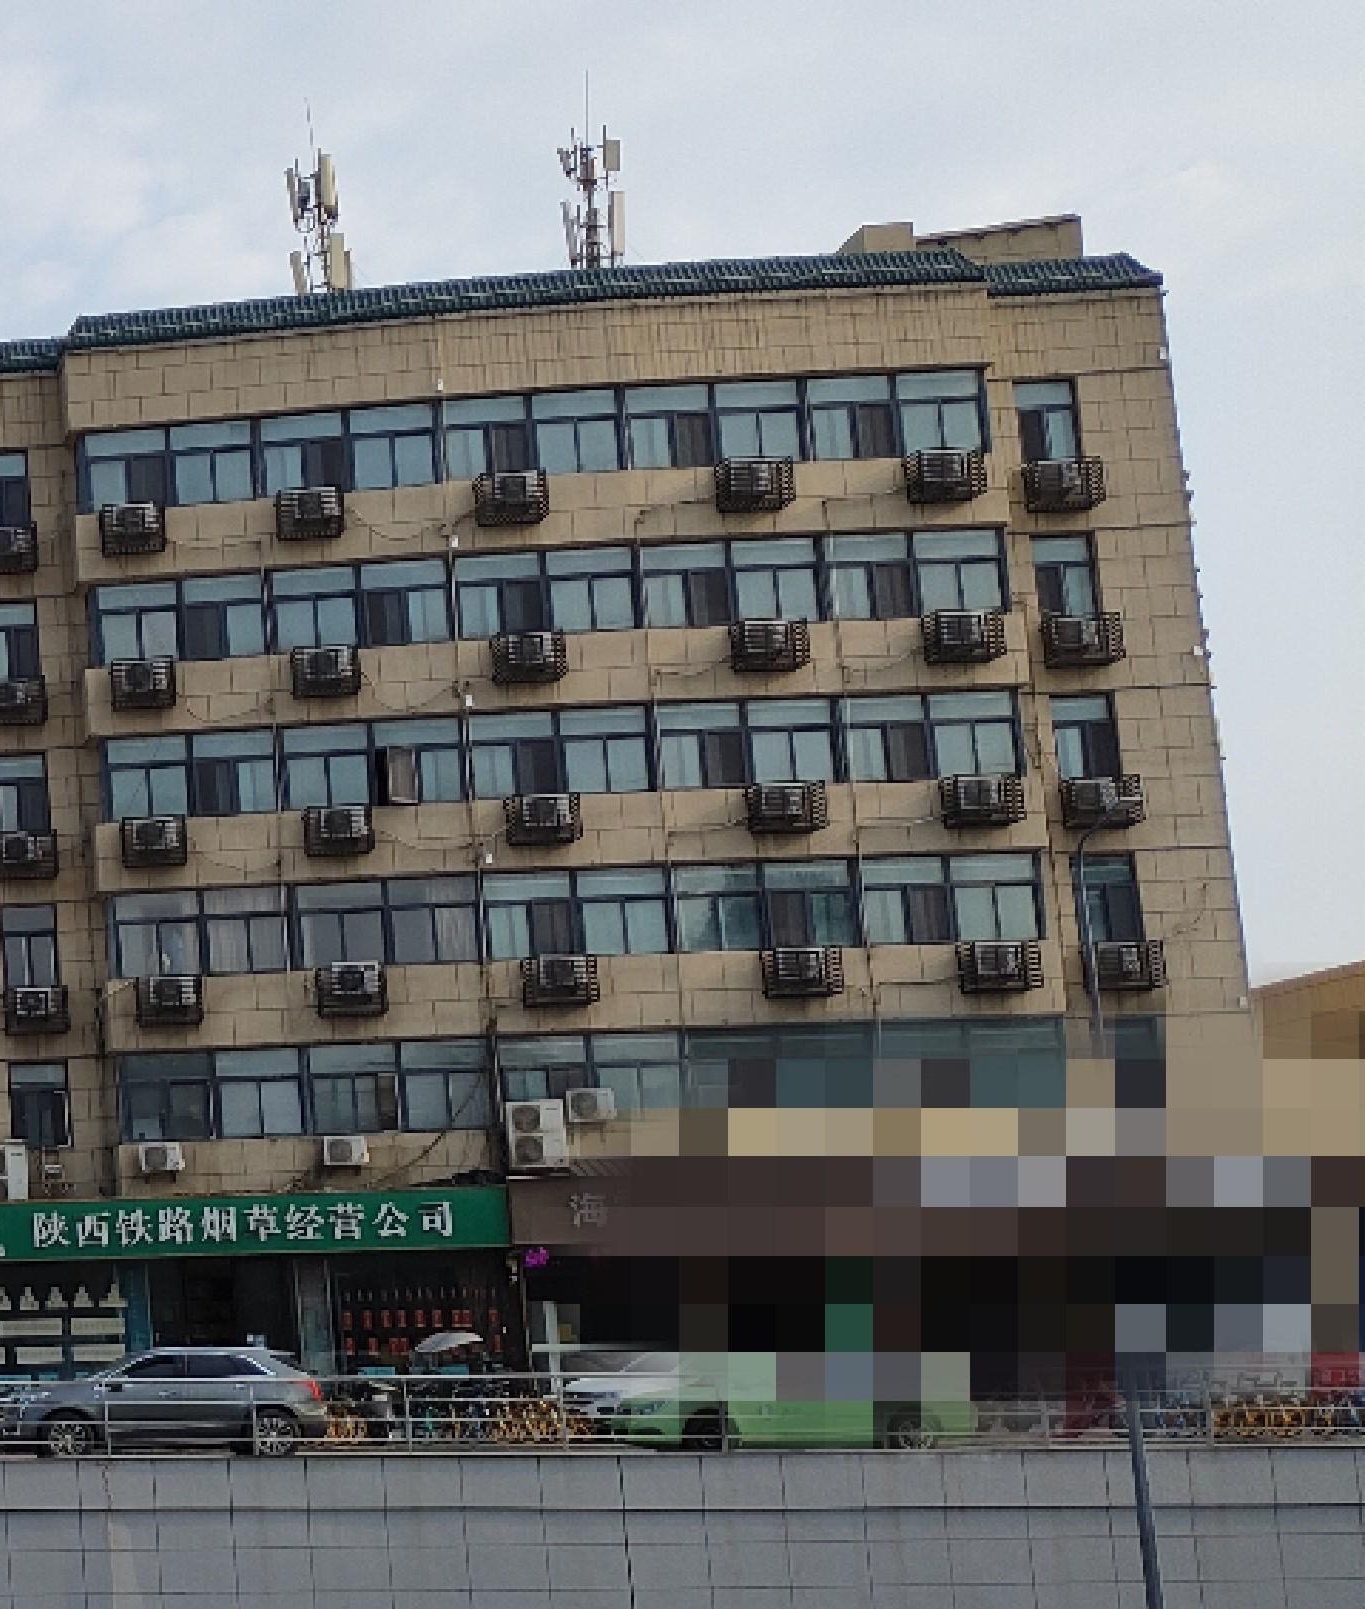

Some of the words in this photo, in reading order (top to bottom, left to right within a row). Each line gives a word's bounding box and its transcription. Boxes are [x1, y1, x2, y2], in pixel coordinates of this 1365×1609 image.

[33, 1201, 453, 1248] 陕西铁路烟草经营公司
